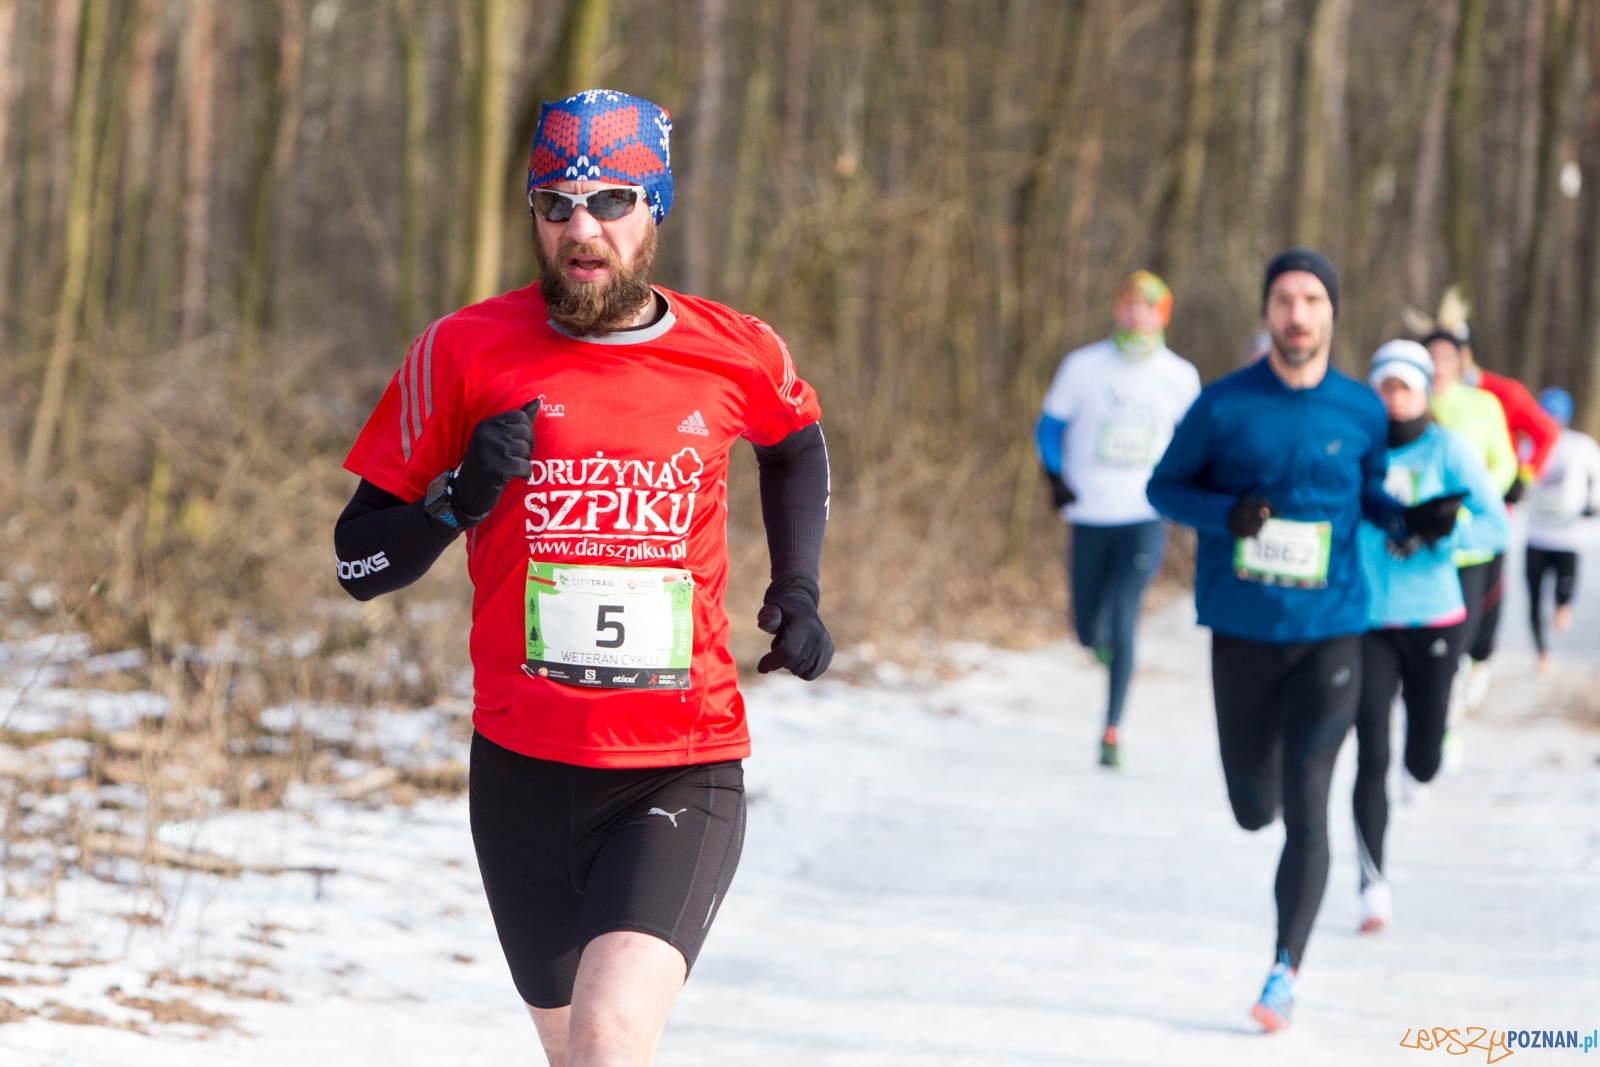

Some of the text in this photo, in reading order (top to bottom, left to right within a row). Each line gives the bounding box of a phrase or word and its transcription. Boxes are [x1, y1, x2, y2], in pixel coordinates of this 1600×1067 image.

[677, 424, 709, 437] adidas
[527, 451, 677, 490] DRUŻYNA
[524, 488, 696, 535] SZPIKU
[529, 538, 687, 562] www.darszpiku.pl
[595, 604, 626, 649] 5
[677, 616, 688, 656] Poznań
[560, 650, 659, 667] WETERAN CYKLU
